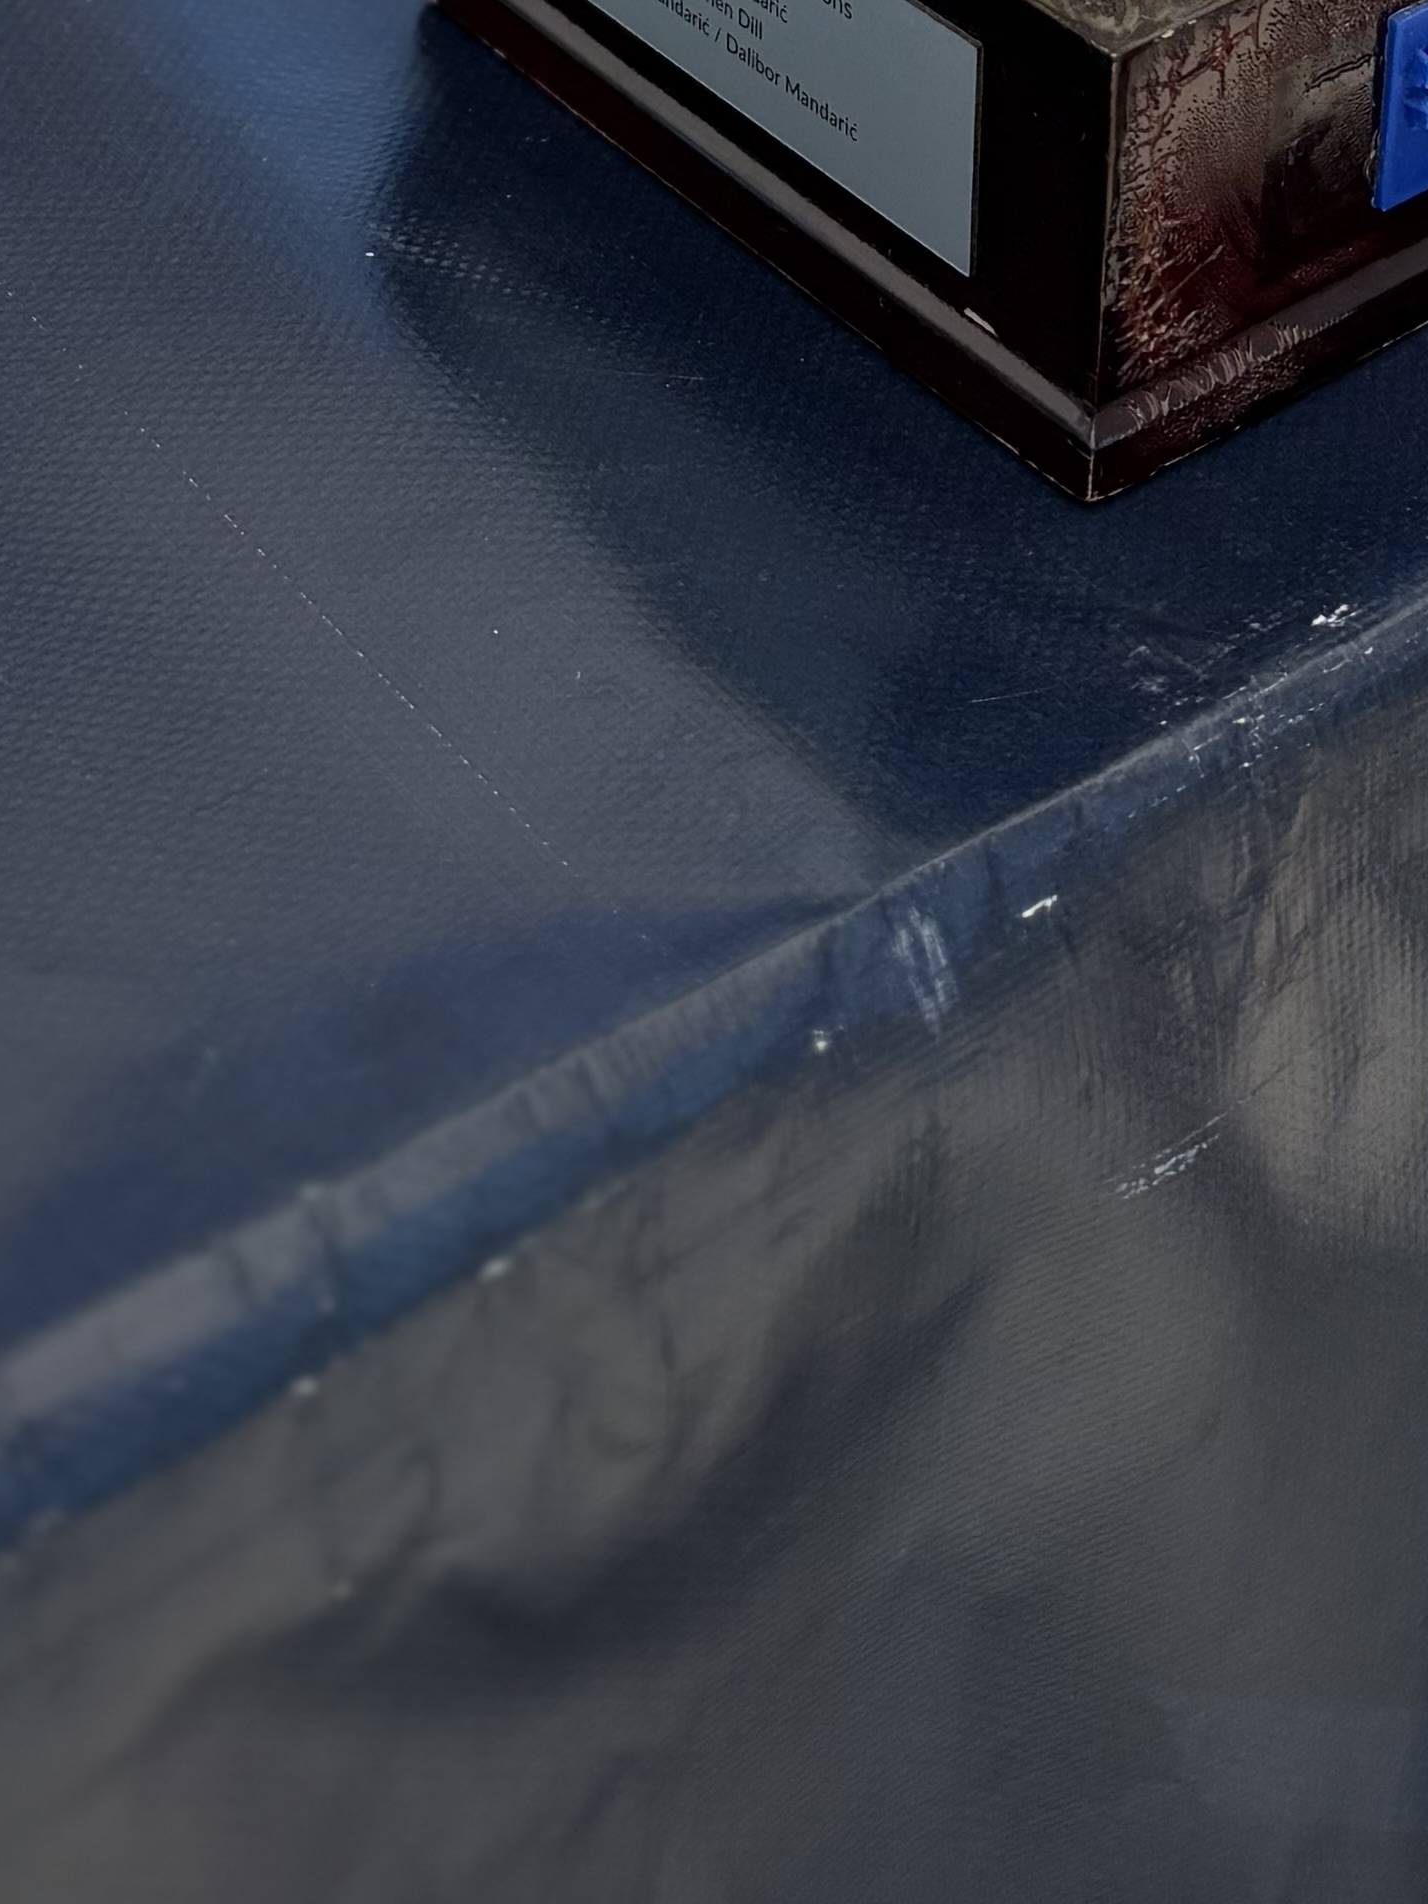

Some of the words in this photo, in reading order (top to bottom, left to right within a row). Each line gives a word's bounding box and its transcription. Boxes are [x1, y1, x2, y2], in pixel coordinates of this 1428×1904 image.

[738, 8, 763, 40] Dill
[714, 28, 721, 42] /
[726, 33, 780, 86] Dalibor
[786, 75, 858, 141] Mandarić
